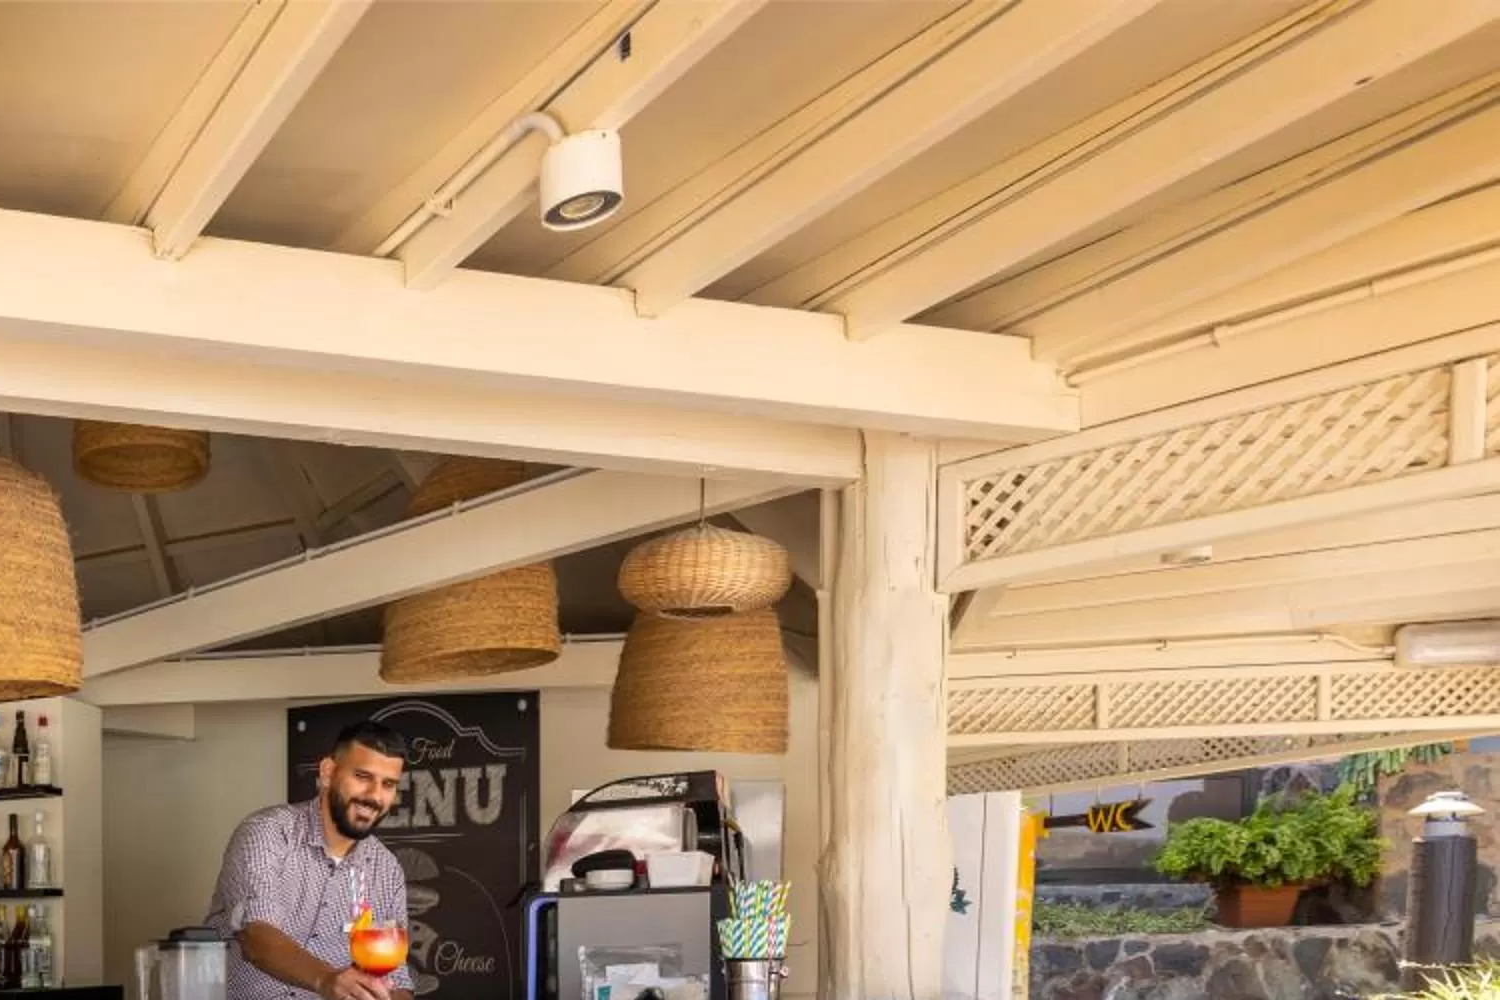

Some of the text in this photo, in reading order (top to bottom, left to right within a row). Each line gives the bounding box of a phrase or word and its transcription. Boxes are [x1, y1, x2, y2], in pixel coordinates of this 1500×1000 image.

[406, 736, 456, 765] Food
[377, 764, 507, 830] ENU
[1087, 801, 1134, 833] WC
